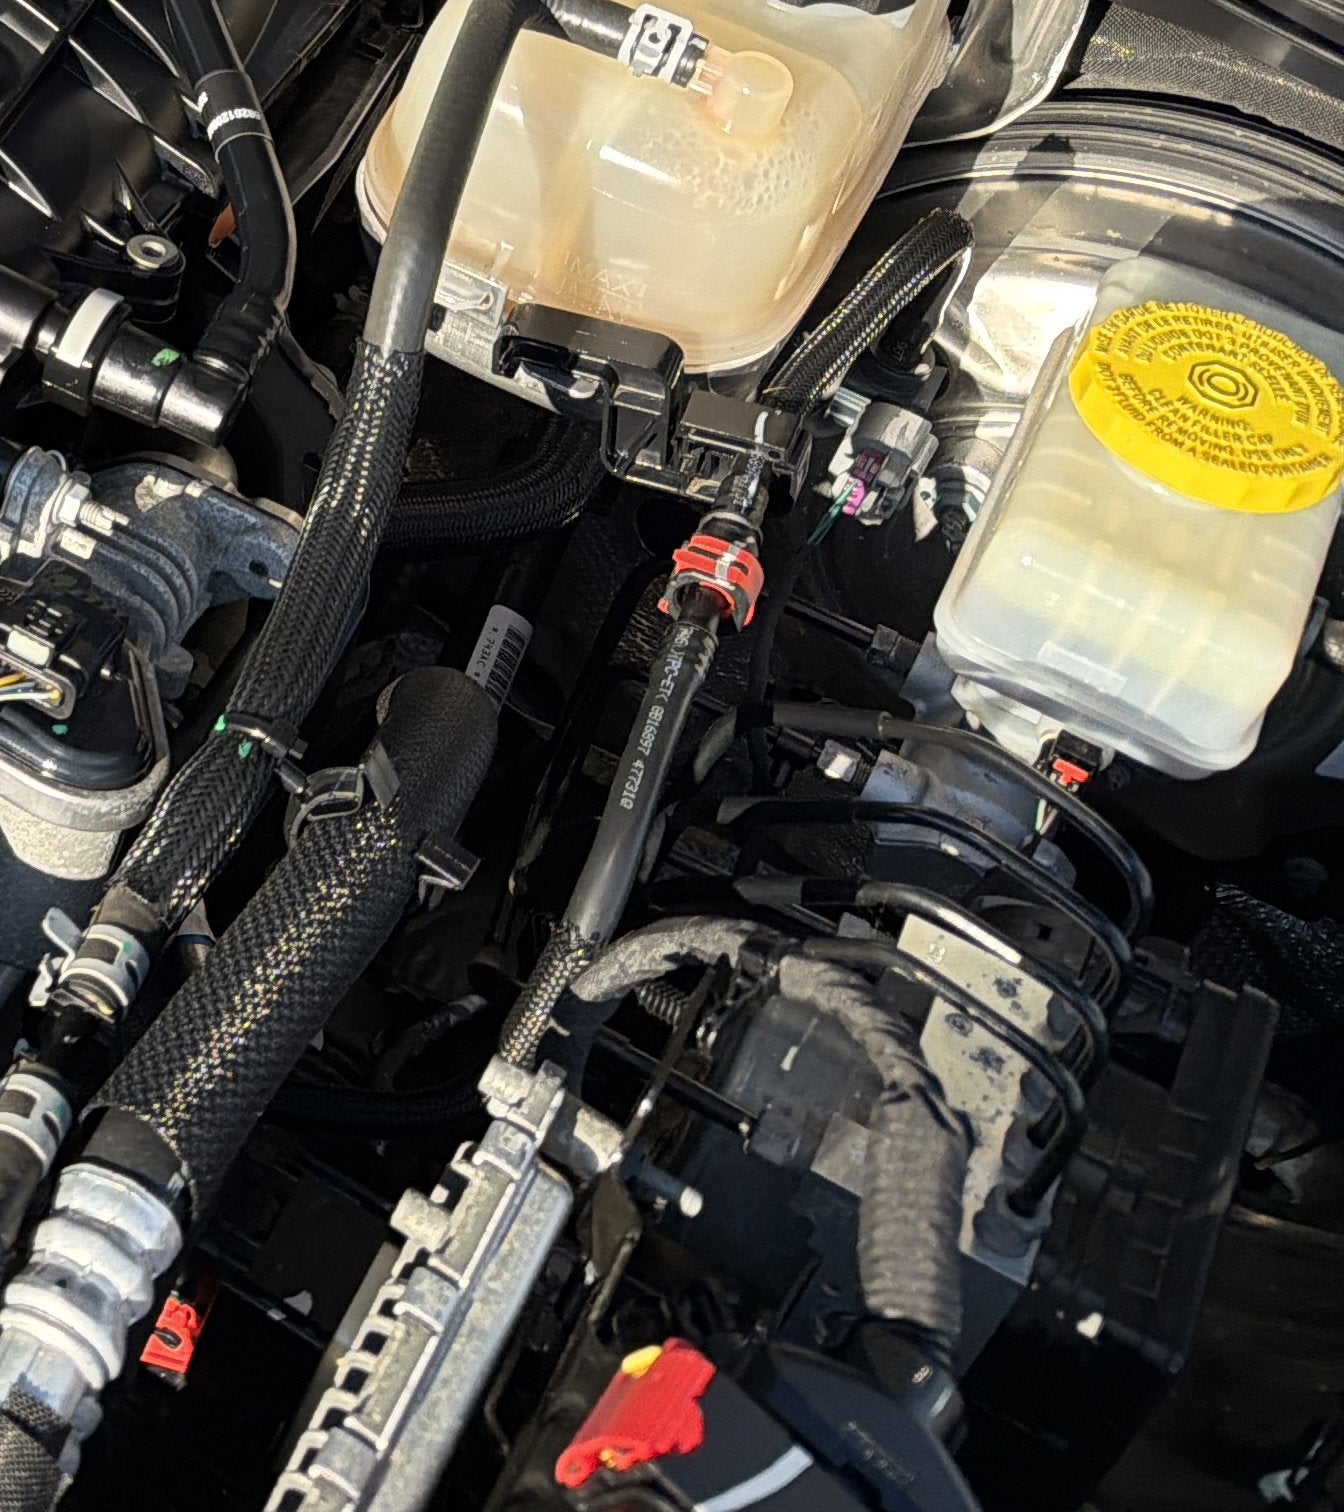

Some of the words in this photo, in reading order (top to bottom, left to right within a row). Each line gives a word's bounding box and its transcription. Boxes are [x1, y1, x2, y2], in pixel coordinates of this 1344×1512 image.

[1189, 327, 1221, 343] DOT
[1111, 391, 1146, 421] FLUID
[1144, 421, 1185, 448] FROM
[1186, 446, 1197, 458] A
[1201, 449, 1260, 475] SEALED
[1118, 373, 1159, 414] BEFORE
[1241, 447, 1272, 461] USE
[1148, 388, 1190, 423] CLEAN
[1191, 419, 1244, 446] FILLER
[1246, 433, 1274, 446] CAP
